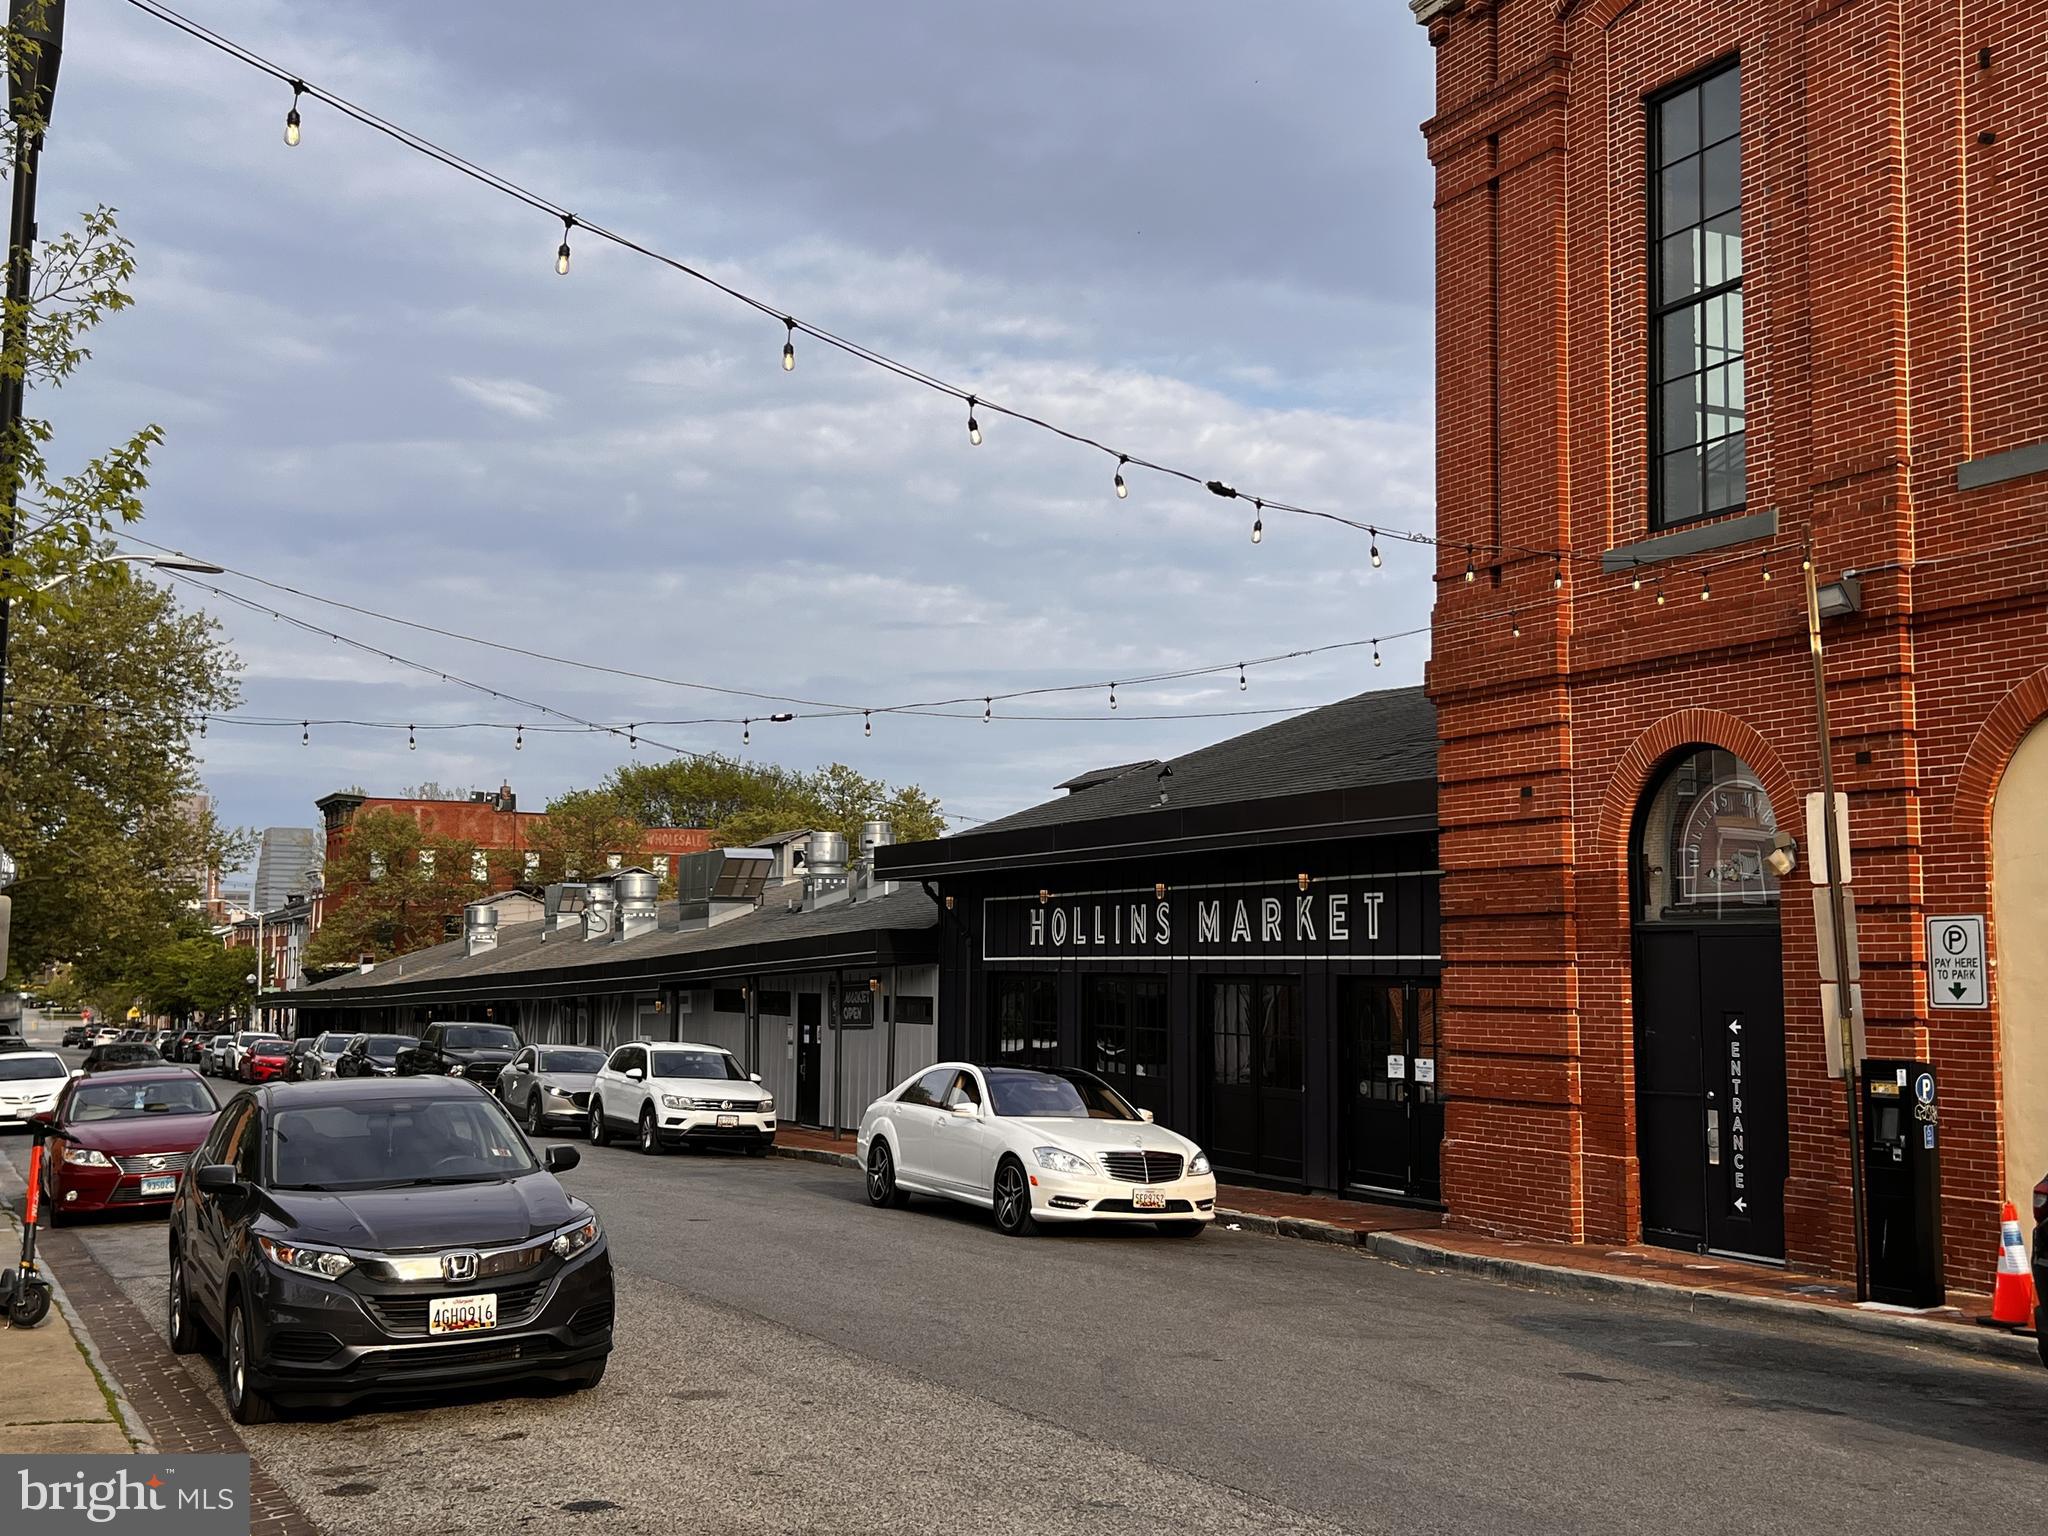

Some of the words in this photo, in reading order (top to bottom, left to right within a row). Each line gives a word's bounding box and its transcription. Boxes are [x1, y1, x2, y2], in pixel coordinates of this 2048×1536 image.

[646, 832, 703, 847] WHOLESALE
[1689, 792, 1729, 868] HOLLINS
[1030, 902, 1171, 946] HOLLINS
[1198, 892, 1384, 943] MARKET
[1934, 958, 1952, 969] PAY
[1955, 957, 1979, 969] HERE
[1937, 969, 1949, 980] TO
[1952, 969, 1976, 980] PARK
[843, 1006, 862, 1020] OPEN
[1730, 1041, 1745, 1189] ENTRANCE
[434, 1304, 493, 1328] 4GH0916
